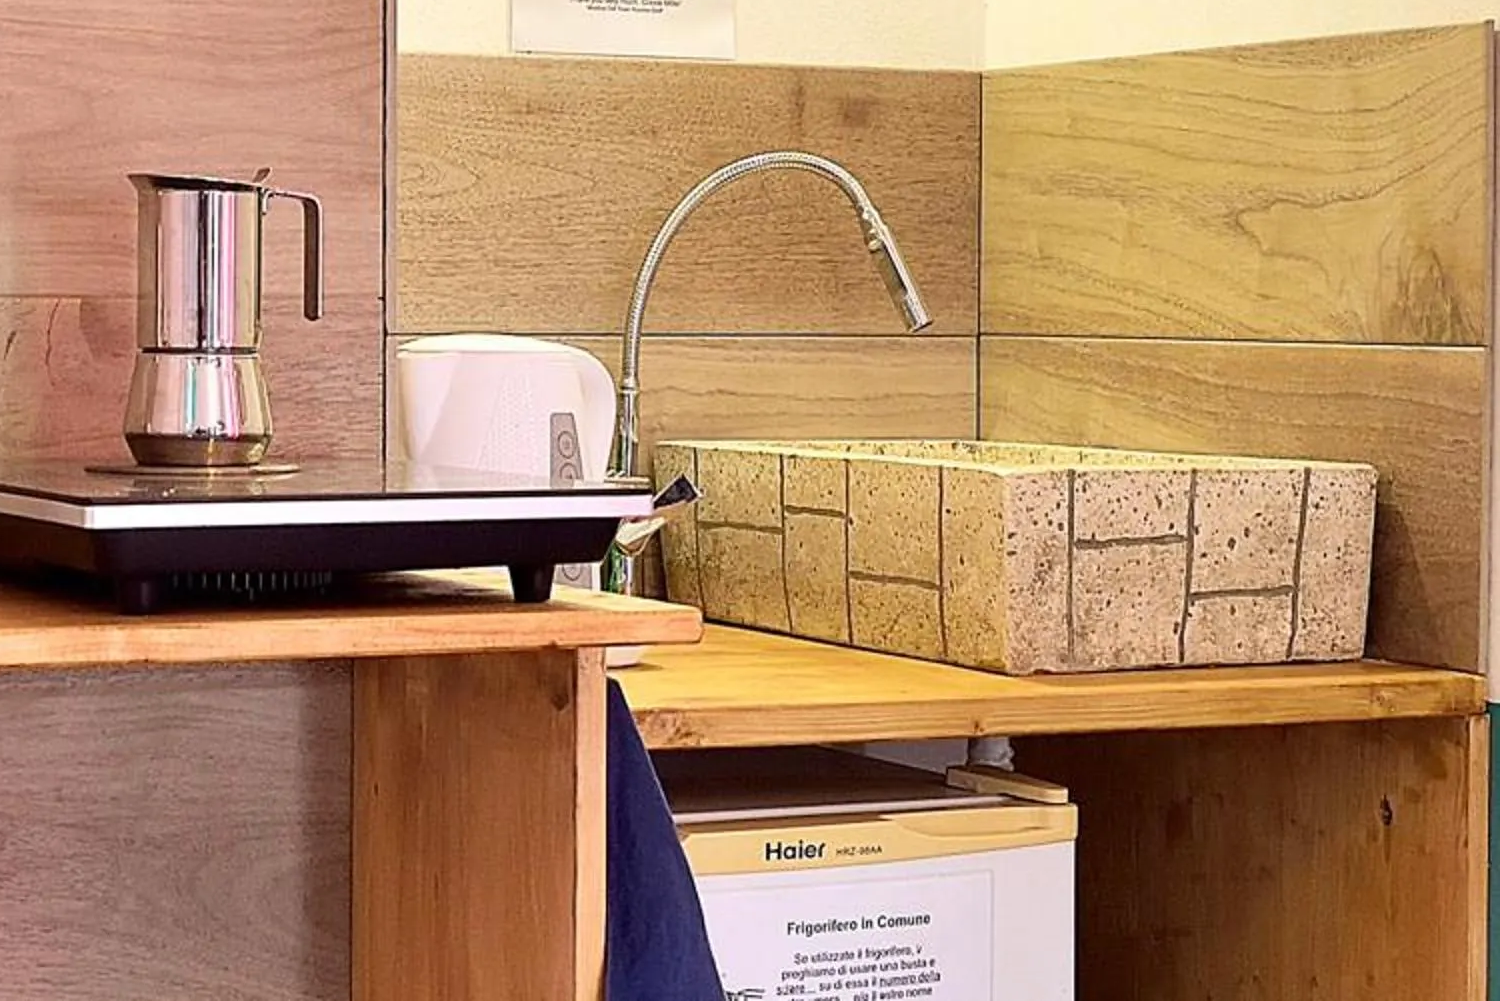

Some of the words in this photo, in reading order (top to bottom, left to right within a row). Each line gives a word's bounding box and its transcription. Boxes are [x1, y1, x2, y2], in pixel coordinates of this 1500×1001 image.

[765, 840, 826, 861] Haier
[787, 918, 858, 937] Frigorifero
[861, 916, 873, 929] in
[877, 913, 931, 928] Comune
[811, 950, 855, 964] utilizzate
[781, 966, 835, 981] preghiamo
[849, 962, 877, 974] usare
[879, 961, 899, 972] una
[901, 958, 927, 971] busta
[845, 977, 870, 988] essa
[879, 973, 916, 987] numero
[905, 985, 933, 998] nome
